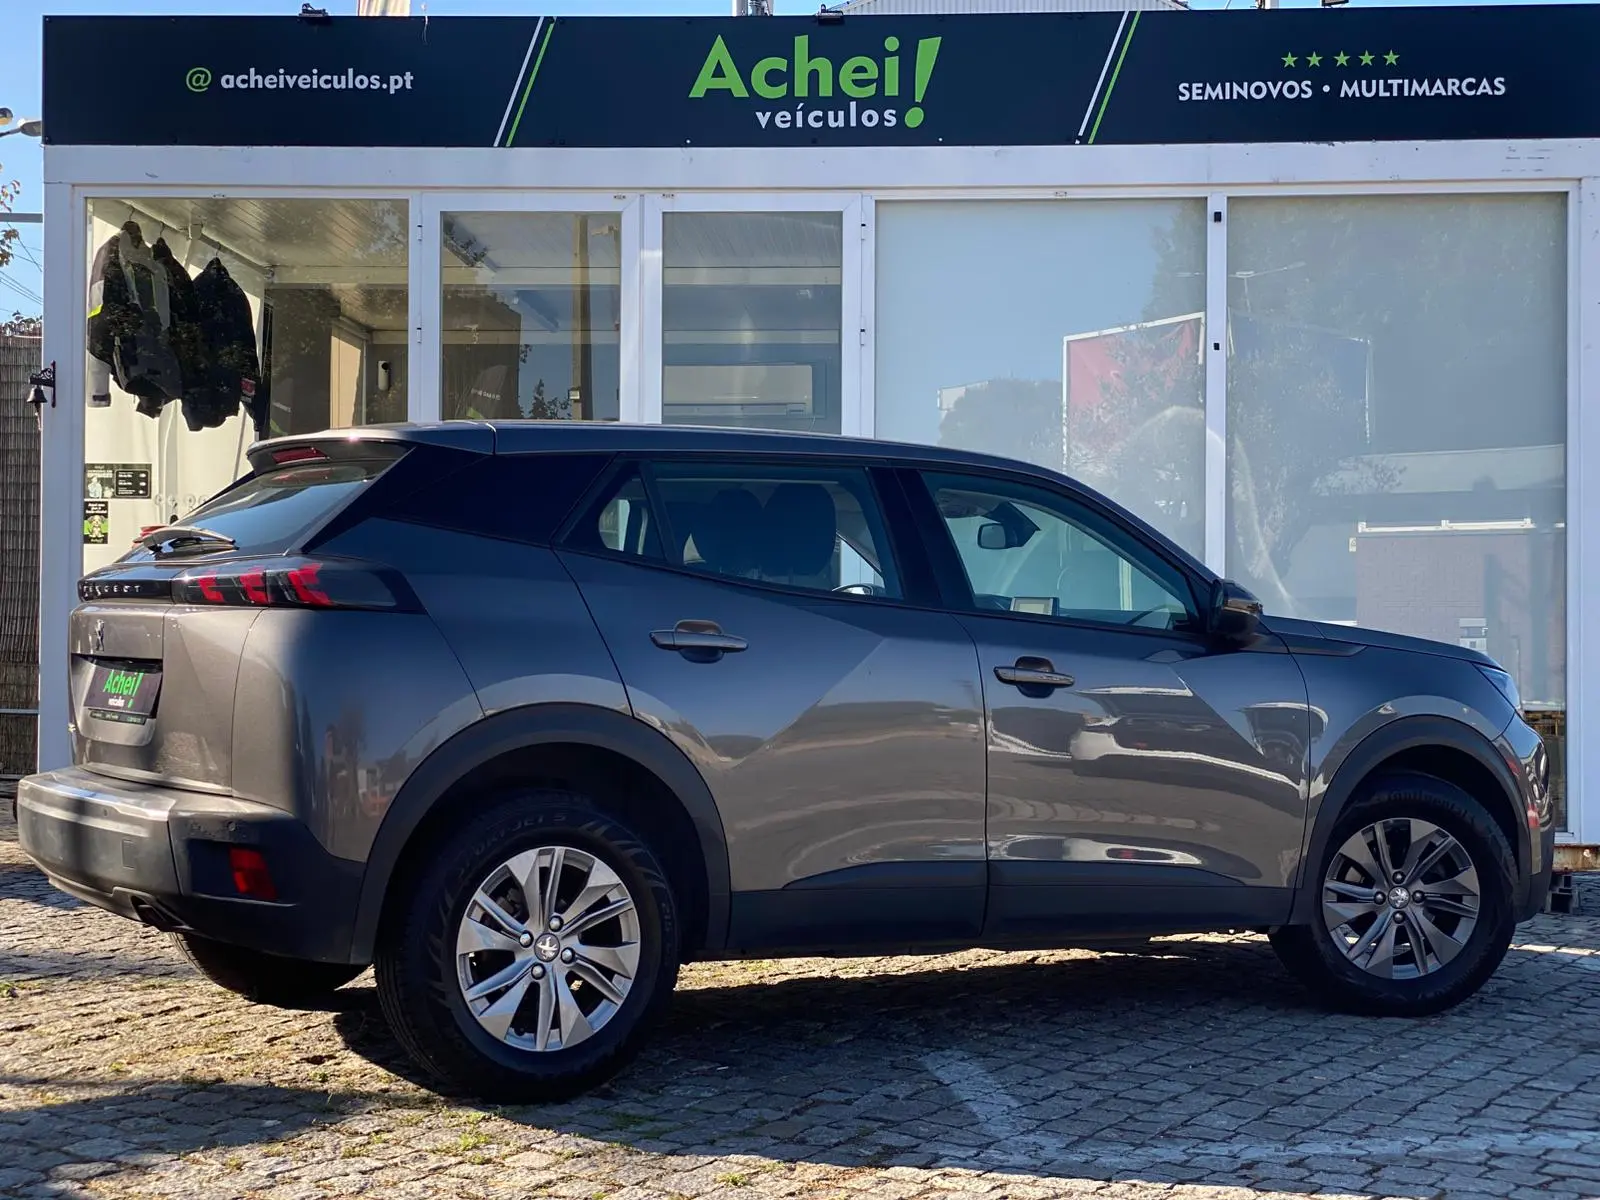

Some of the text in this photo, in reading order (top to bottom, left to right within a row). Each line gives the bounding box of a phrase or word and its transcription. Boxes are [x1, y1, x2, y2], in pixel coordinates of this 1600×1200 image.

[220, 67, 414, 95] acheiveiculos.pt
[689, 35, 942, 128] Achei!
[1178, 77, 1506, 101] SEMINOVOS MULTIMARCAS
[756, 99, 897, 129] veículos
